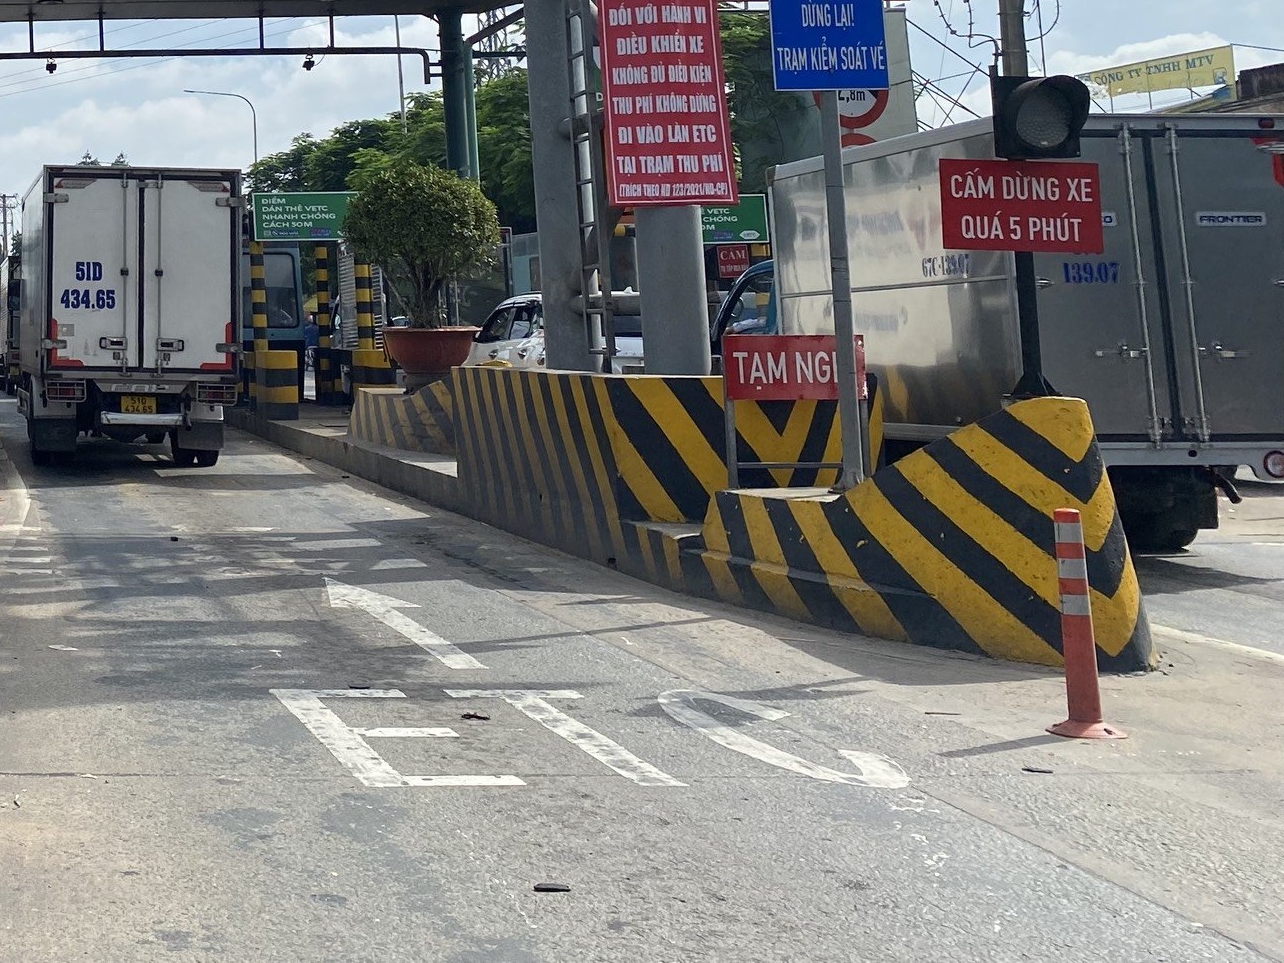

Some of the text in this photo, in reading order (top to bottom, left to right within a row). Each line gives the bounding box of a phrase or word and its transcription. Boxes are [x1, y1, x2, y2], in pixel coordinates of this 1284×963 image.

[609, 3, 707, 26] ĐỐI VỚI HÀNH VI
[834, 4, 855, 30] LẠI!
[617, 29, 705, 56] ĐIỀU KHIỂN XE
[777, 36, 885, 75] TRẠM KIỂM SOÁT VÉ
[1146, 61, 1181, 75] TNHH
[1185, 54, 1215, 69] MTV
[612, 59, 712, 86] KHÔNG ĐỦ ĐIỀU KIỆN
[612, 97, 633, 114] THU
[636, 93, 653, 114] PHÍ
[656, 92, 688, 113] KHÔNG
[690, 92, 716, 113] DỪNG
[618, 122, 717, 144] ĐI VÀO LÀN ETC
[617, 152, 724, 177] TẠI TRẠM THU PHÍ
[950, 168, 1093, 202] CẤM DỪNG XE
[961, 210, 1082, 242] QUÁ 5 PHÚT
[1199, 215, 1264, 224] FRONTIER
[75, 261, 103, 281] 51D
[1063, 261, 1120, 284] 139.07
[60, 289, 116, 309] 434.65
[732, 351, 788, 391] TẠM
[268, 689, 911, 790] ETC
